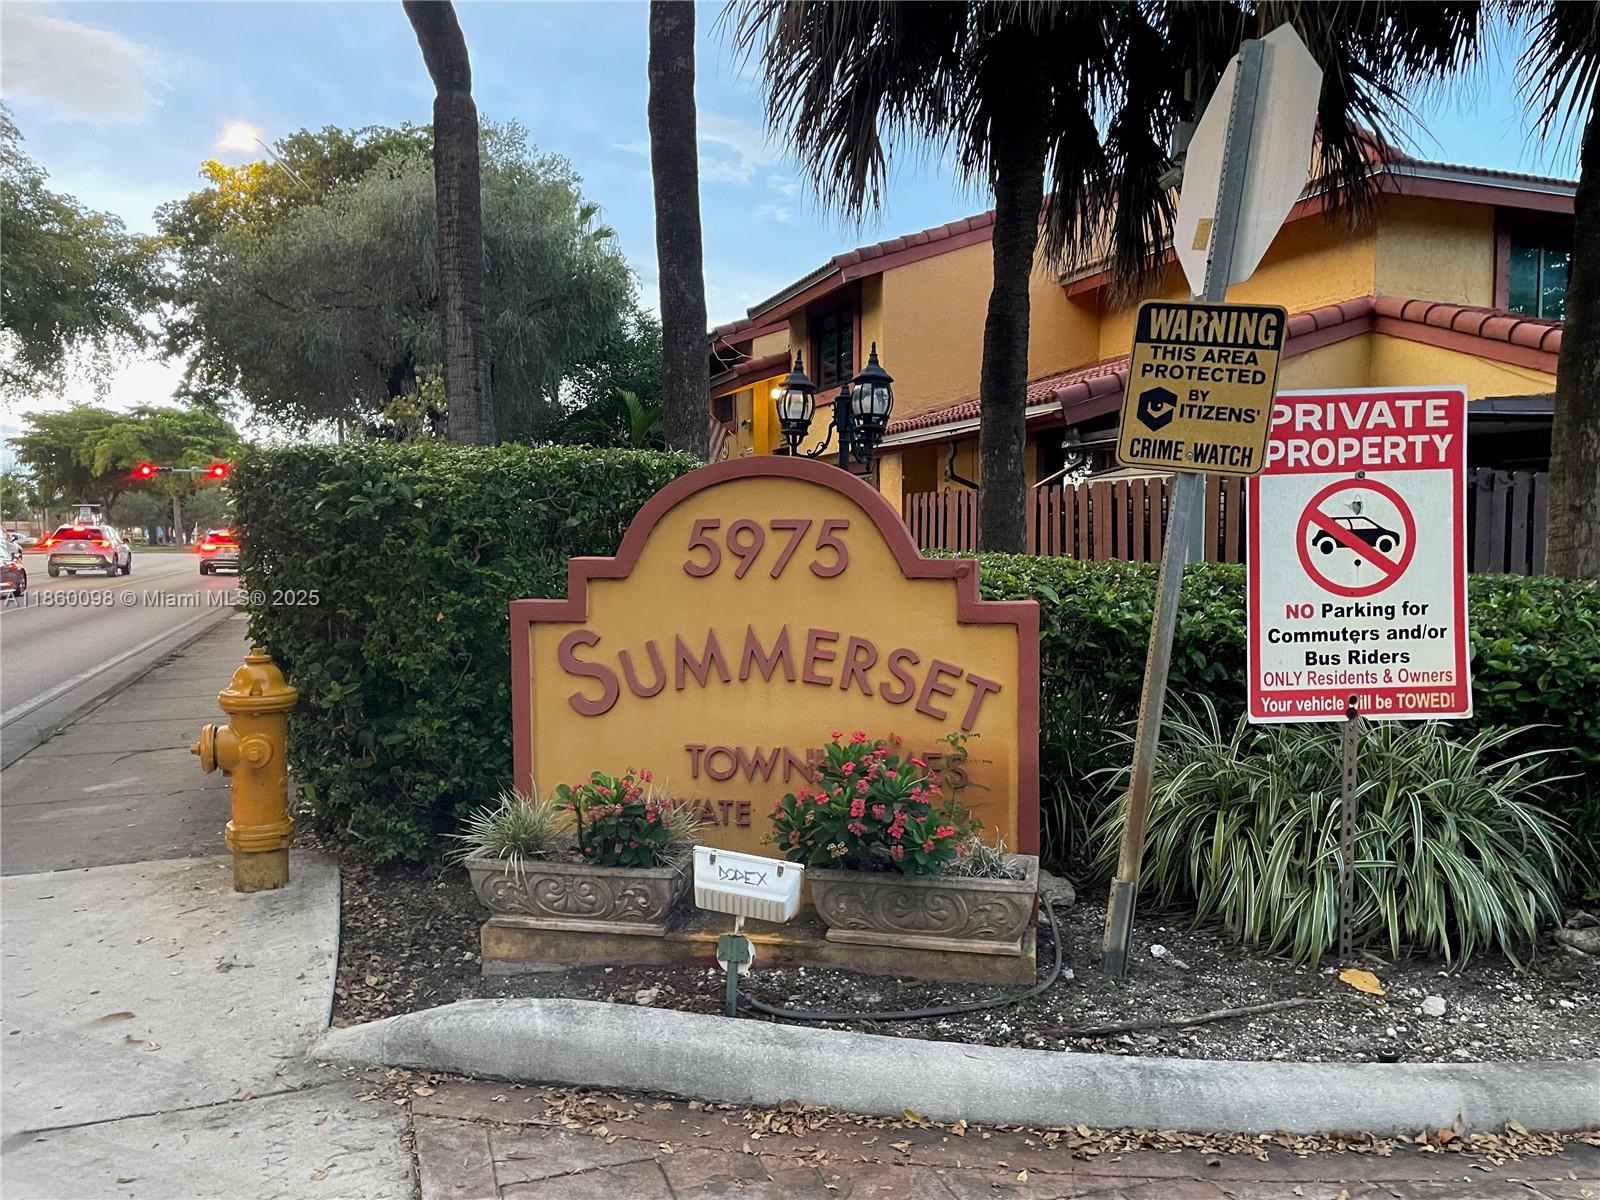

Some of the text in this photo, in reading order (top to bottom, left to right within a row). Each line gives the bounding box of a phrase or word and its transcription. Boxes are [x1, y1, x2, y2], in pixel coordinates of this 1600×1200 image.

[1150, 308, 1278, 347] WARNING
[1150, 345, 1259, 366] THIS AREA
[1141, 363, 1266, 385] PROTECTED
[1188, 389, 1211, 402] BY
[1270, 399, 1449, 432] PRIVATE
[1129, 437, 1254, 468] CRIME WATCH
[1264, 434, 1454, 468] PROPERTY
[683, 518, 850, 579] 5975
[1285, 601, 1429, 621] NO Parking for
[1267, 624, 1448, 644] Commuters and/or
[1305, 649, 1411, 666] Bus Riders
[556, 623, 1002, 732] SUMMERSET
[1263, 667, 1453, 687] ONLY Residents & Owners
[1260, 697, 1292, 713] Your
[1296, 695, 1345, 711] vehicle
[1375, 694, 1393, 710] be
[1396, 692, 1456, 709] TOWED!
[684, 744, 969, 790] TOWNES
